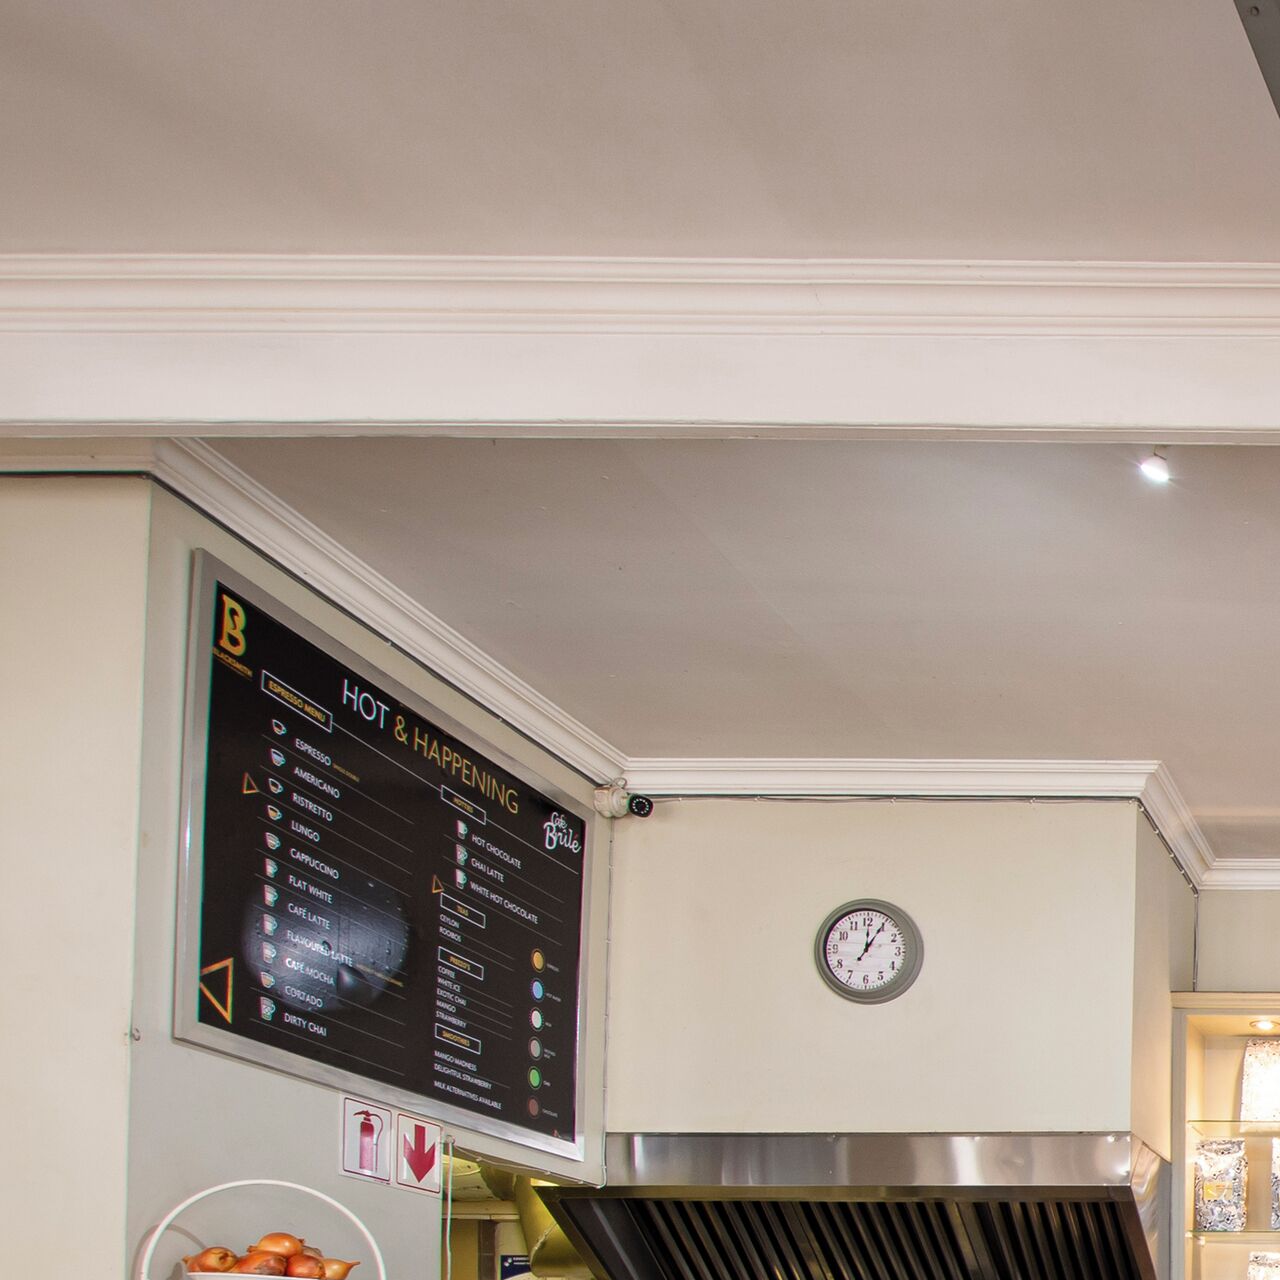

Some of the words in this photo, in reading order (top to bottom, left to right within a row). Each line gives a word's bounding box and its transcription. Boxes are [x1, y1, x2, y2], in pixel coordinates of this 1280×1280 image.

[268, 680, 303, 708] ESPRESSO
[304, 703, 326, 722] MENU
[295, 738, 332, 766] ESPRESSO
[343, 679, 390, 729] HOT
[394, 715, 408, 746] &
[414, 727, 519, 814] HAPPENING
[294, 767, 340, 798] AMERICANO
[292, 792, 333, 821] RISTRETTO
[453, 797, 474, 813] HOTTIES
[291, 820, 320, 842] LUNGO
[543, 821, 582, 853] Brûlé
[471, 834, 486, 848] HOT
[486, 843, 522, 870] CHOCOLATE
[290, 848, 339, 880] CAPPUCCINO
[471, 858, 487, 872] CHAI
[487, 866, 505, 883] LATTE
[289, 875, 307, 891] FLAT
[309, 885, 333, 904] WHITE
[470, 881, 489, 898] WHITE
[490, 893, 503, 905] HOT
[504, 900, 538, 925] CHOCOLATE
[288, 902, 307, 919] CAFÉ
[308, 912, 330, 930] LATTE
[439, 914, 459, 928] CEYLON
[850, 921, 857, 930] 11
[863, 917, 873, 926] 12
[839, 931, 848, 940] 10
[891, 933, 897, 942] 2
[287, 930, 330, 956] FLAVOURED
[331, 951, 353, 967] LATTE
[832, 944, 838, 954] 9
[895, 947, 901, 956] 3
[285, 958, 305, 973] CAFÉ
[305, 967, 335, 985] MOCHA
[438, 966, 455, 979] COFFEE
[837, 959, 843, 968] 8
[847, 970, 853, 979] 7
[890, 961, 895, 970] 4
[438, 977, 453, 989] WHITE
[453, 984, 461, 992] ICE
[863, 975, 869, 984] 6
[878, 971, 884, 980] 5
[285, 986, 323, 1008] CORTADO
[436, 988, 454, 1001] EXOTIC
[454, 996, 467, 1006] CHAI
[436, 999, 456, 1013] MANGO
[284, 1013, 307, 1029] DIRTY
[308, 1022, 327, 1037] CHAI
[435, 1011, 467, 1029] STRAWBERRY
[434, 1050, 454, 1063] MANGO
[454, 1058, 477, 1072] MADNESS
[434, 1063, 462, 1080] DELIGHTFUL
[462, 1073, 492, 1090] STRAWBERRY
[433, 1080, 446, 1091] MILK
[446, 1085, 478, 1102] ALTERNATIVES
[479, 1097, 502, 1110] AVAILABLE
